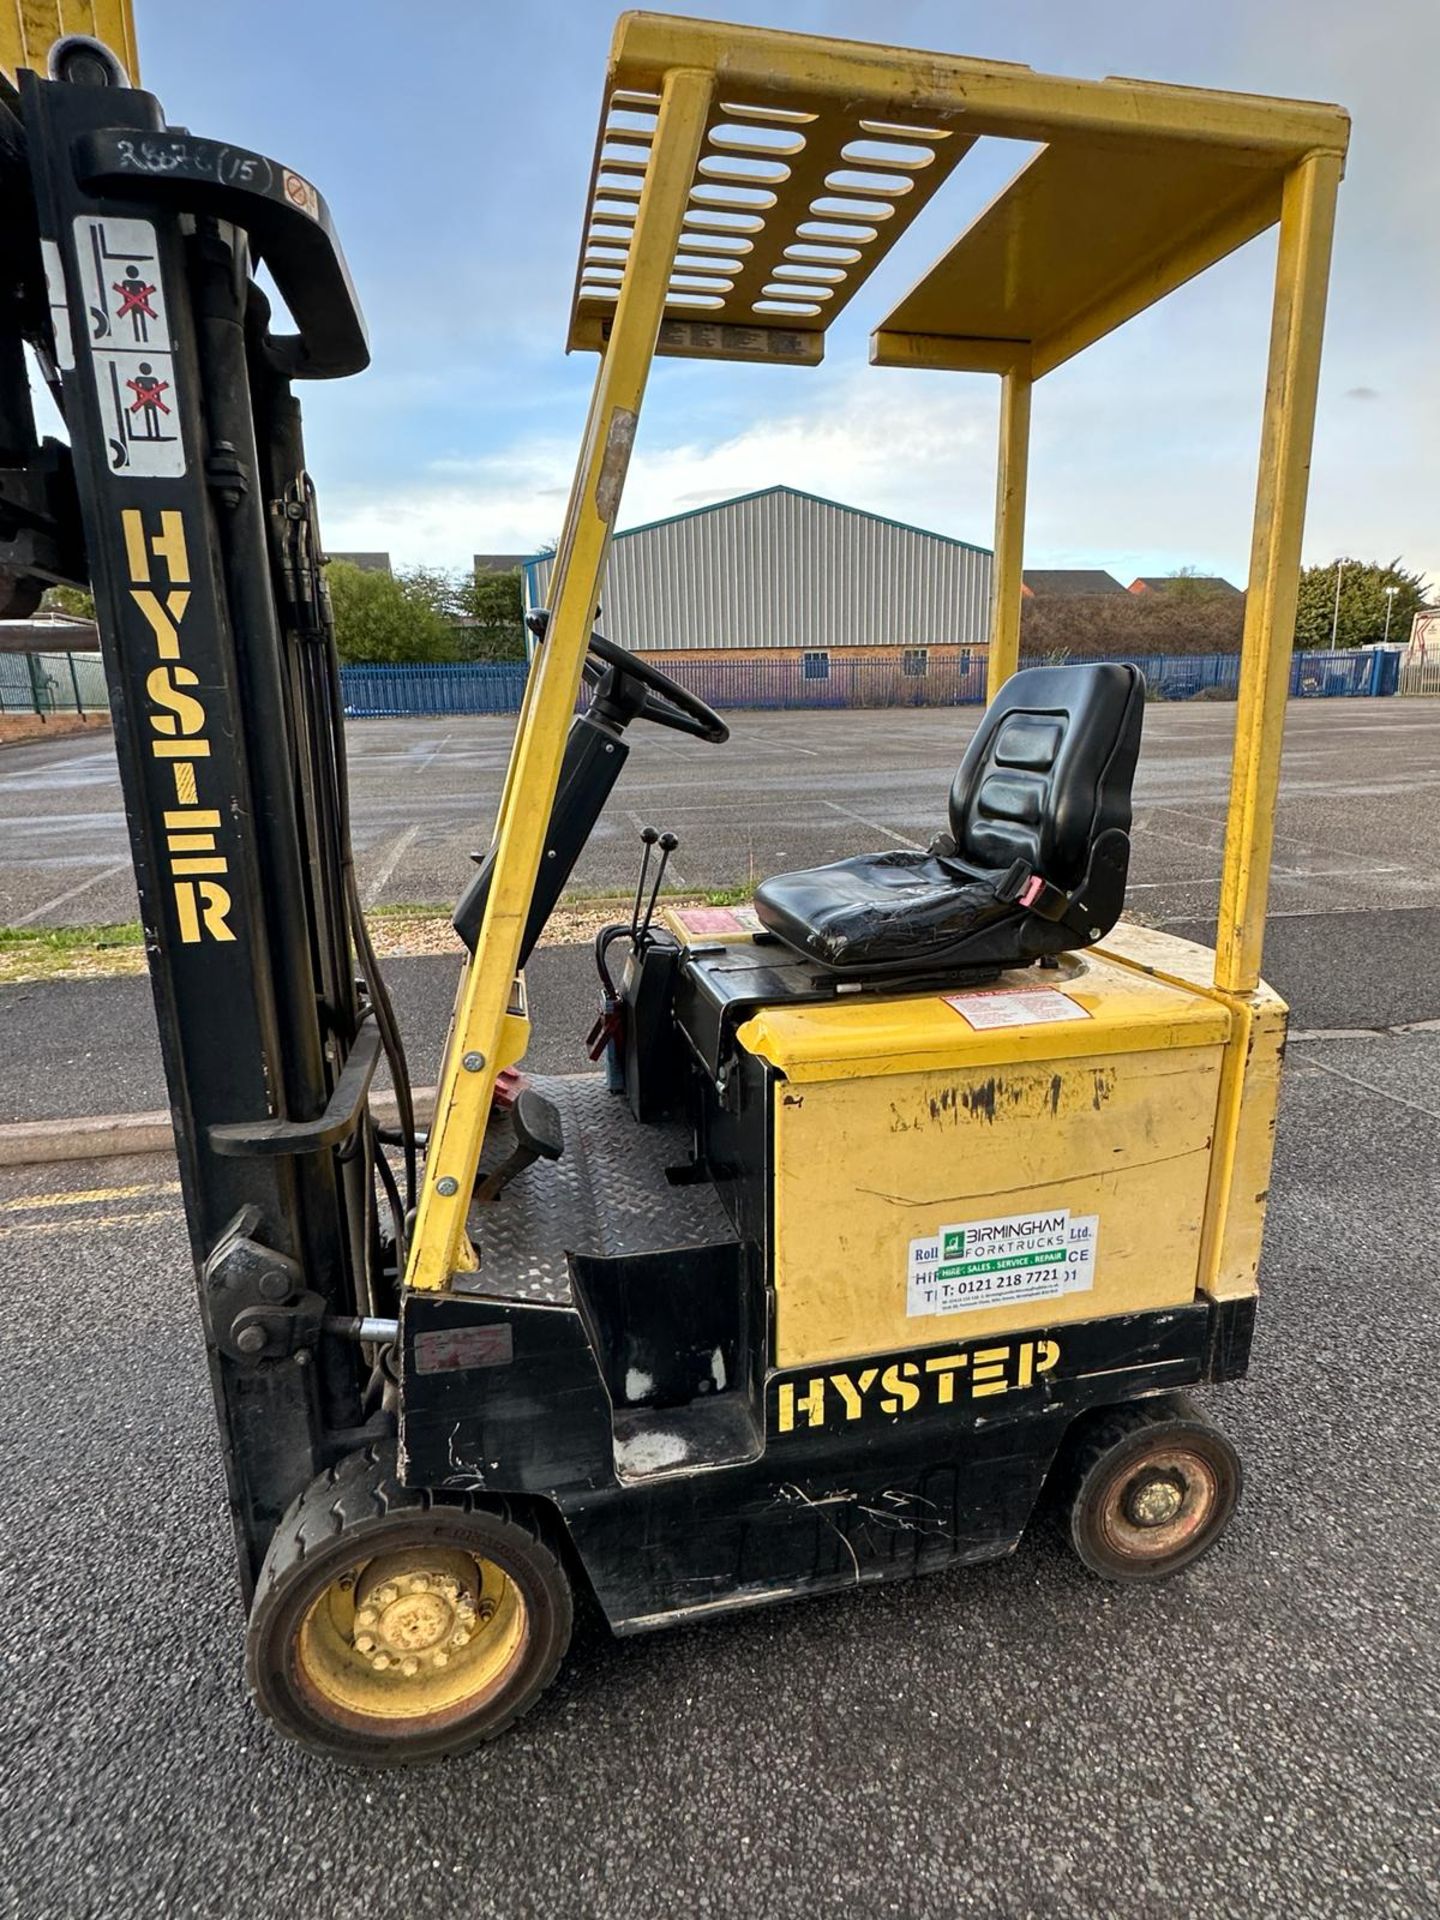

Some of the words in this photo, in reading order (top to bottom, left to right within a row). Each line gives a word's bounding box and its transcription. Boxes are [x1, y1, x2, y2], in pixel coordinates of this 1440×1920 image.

[121, 509, 237, 943] HYSTER
[967, 1216, 1064, 1244] BIRMINGHAM
[1070, 1226, 1092, 1240] Ltd.
[965, 1235, 1064, 1259] FORKTRUCKS
[967, 1263, 991, 1273] SALES
[996, 1258, 1029, 1270] SERVICE
[1035, 1253, 1062, 1264] REPAIR
[942, 1284, 954, 1297] T:
[958, 1278, 991, 1294] 0121
[996, 1273, 1021, 1289] 218
[1025, 1268, 1058, 1285] 7721
